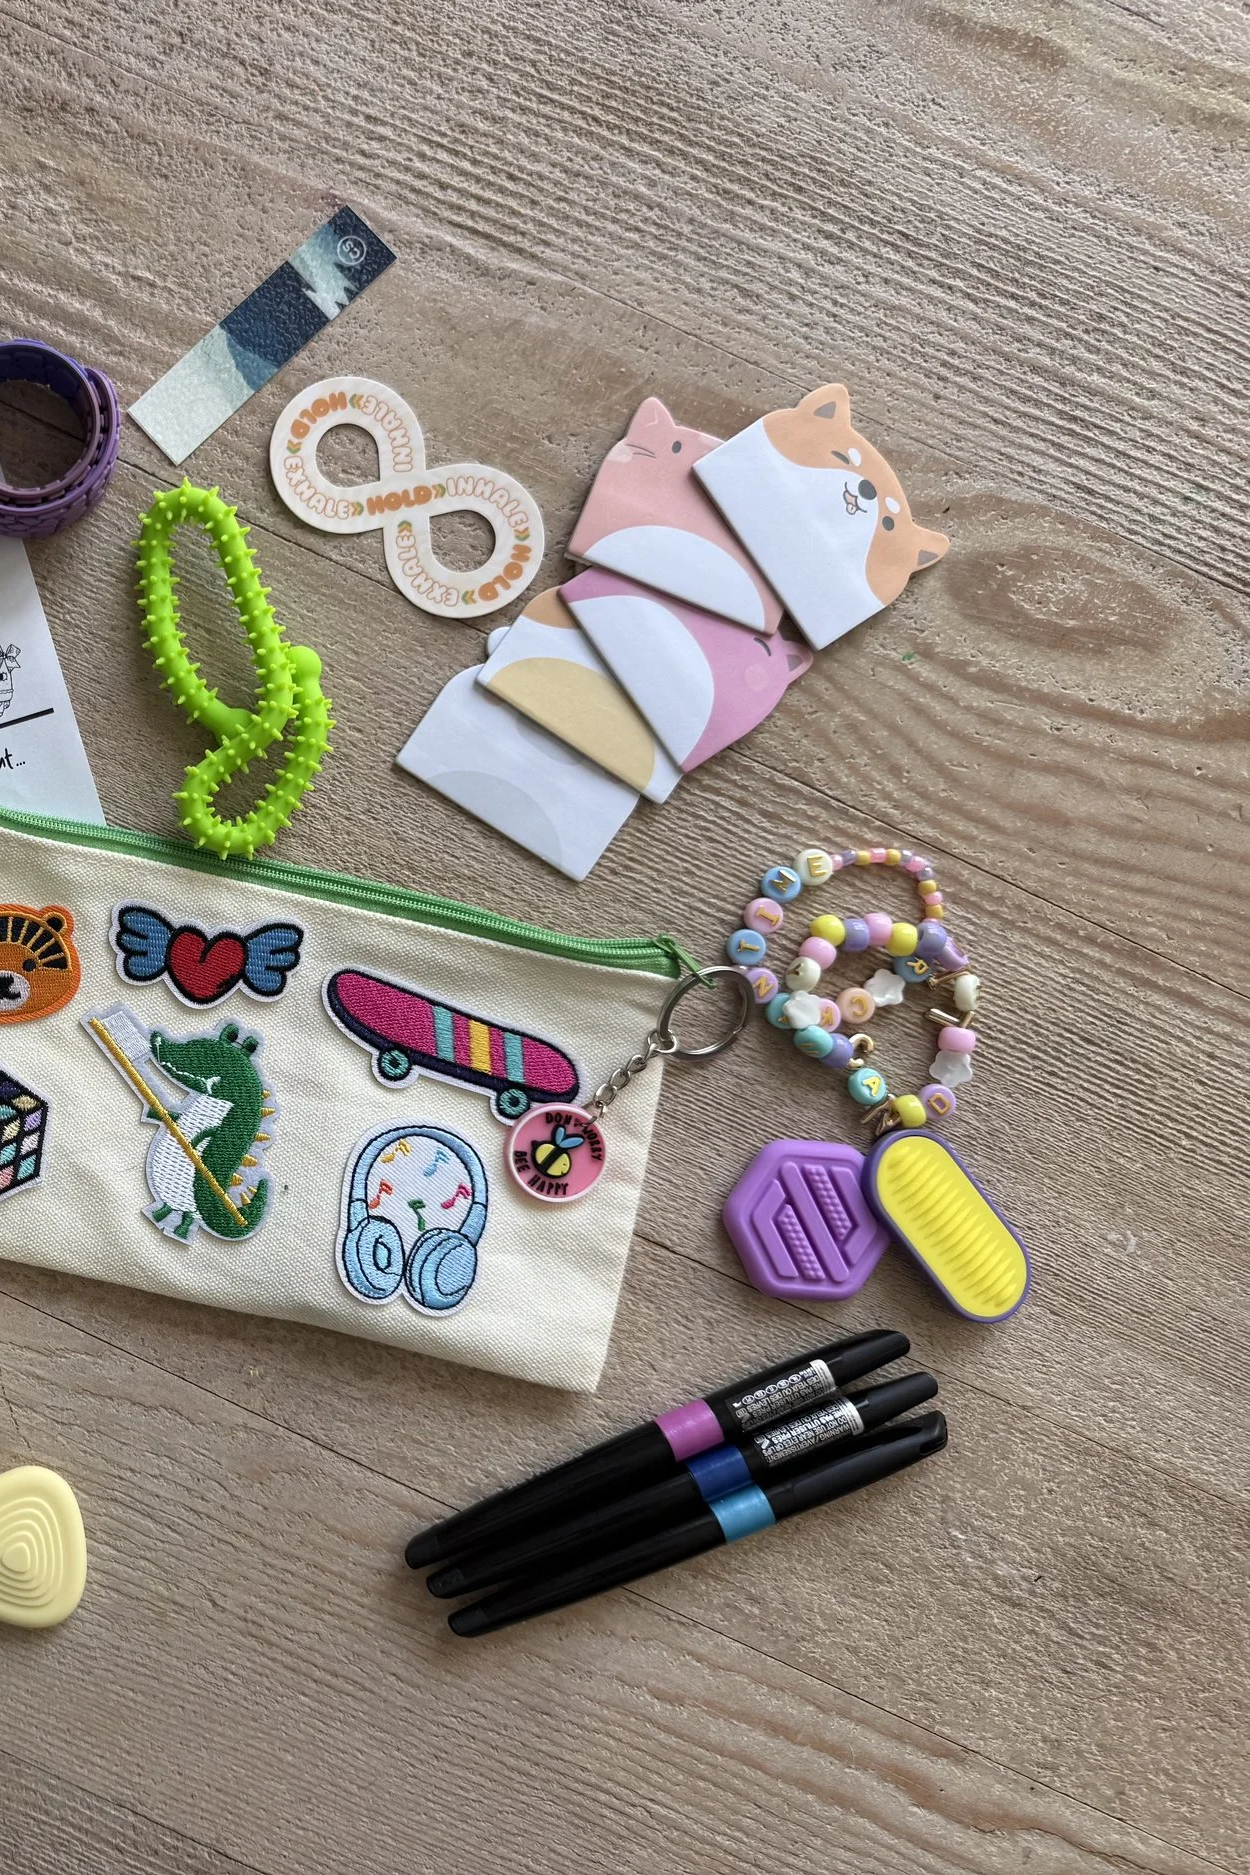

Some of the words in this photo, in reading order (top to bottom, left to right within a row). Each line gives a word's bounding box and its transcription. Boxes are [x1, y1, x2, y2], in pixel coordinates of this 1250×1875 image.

[290, 391, 348, 440] HOLD
[361, 395, 413, 472] INHALE
[284, 456, 350, 520] EXHALE
[366, 485, 432, 516] HOLD
[446, 476, 529, 528] INHALE
[396, 534, 459, 607] EXHALE
[477, 544, 532, 602] HOLD
[514, 1150, 531, 1173] BEE
[527, 1174, 569, 1196] HAPPY
